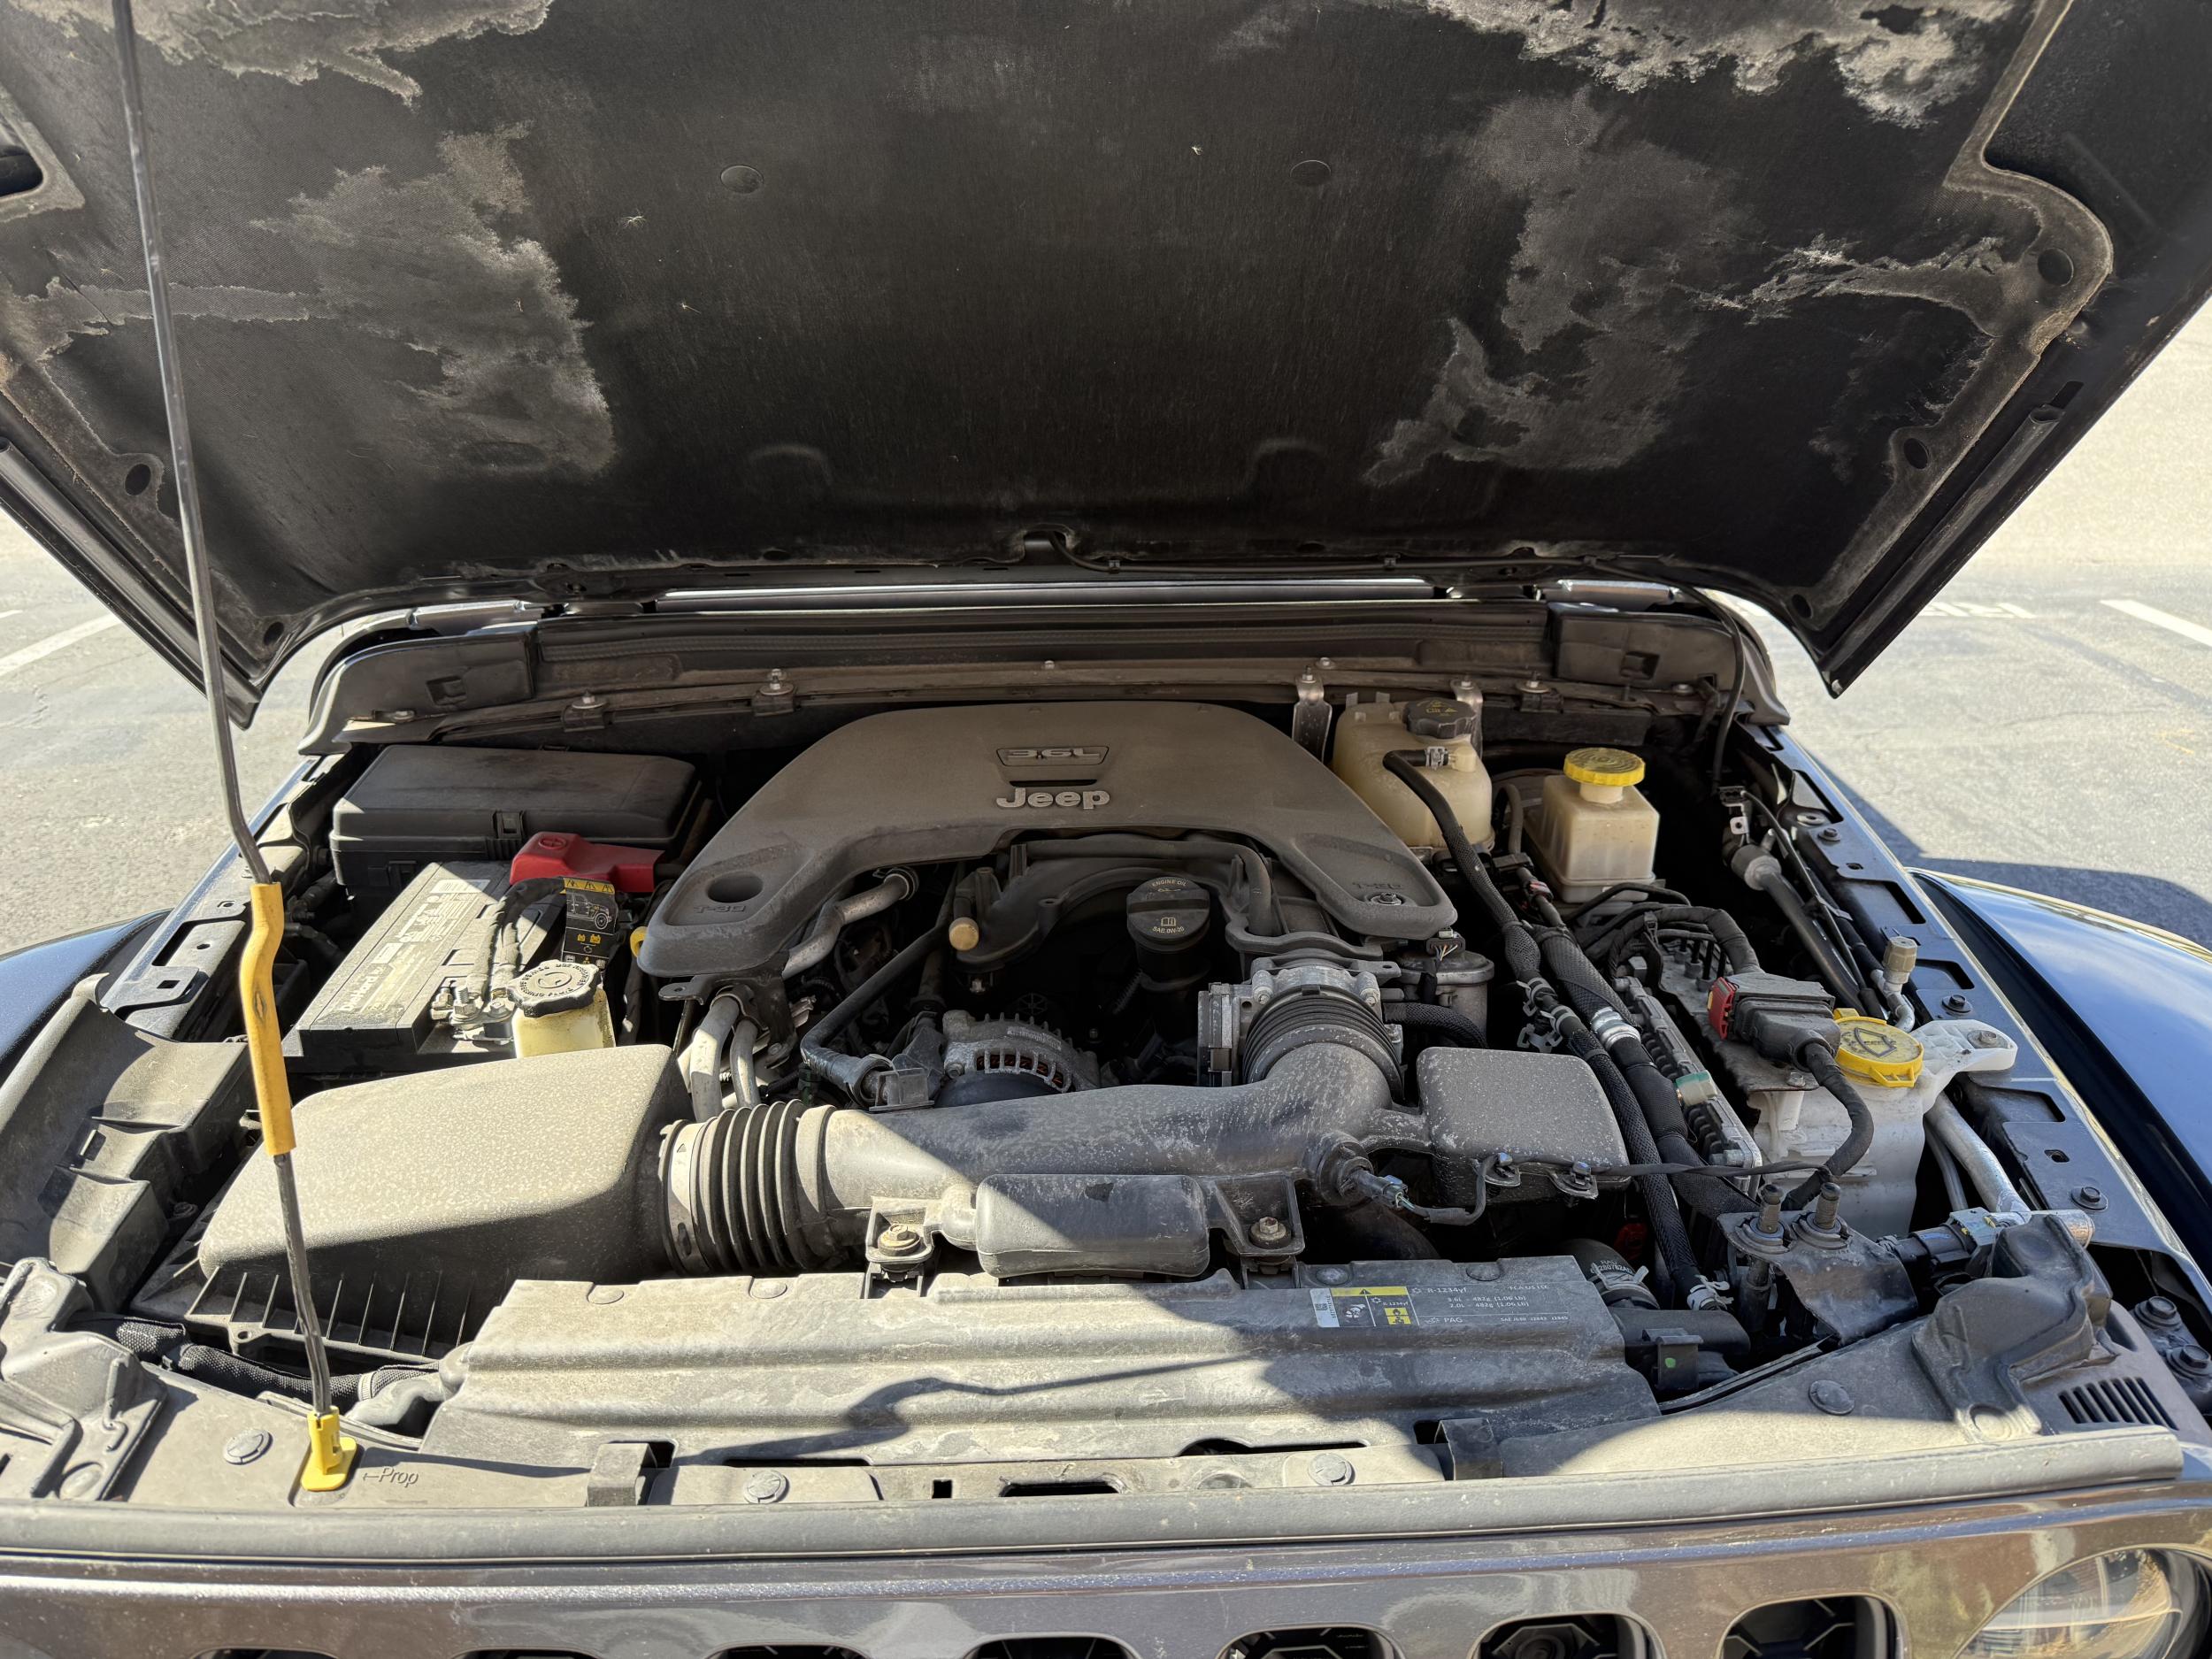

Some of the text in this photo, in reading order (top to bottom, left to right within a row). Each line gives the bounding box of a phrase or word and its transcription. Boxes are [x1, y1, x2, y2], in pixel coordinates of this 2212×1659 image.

[1007, 748, 1100, 760] 3.6L
[995, 787, 1110, 810] Jeep
[340, 975, 379, 1011] DieHard
[379, 1467, 419, 1488] Prop
